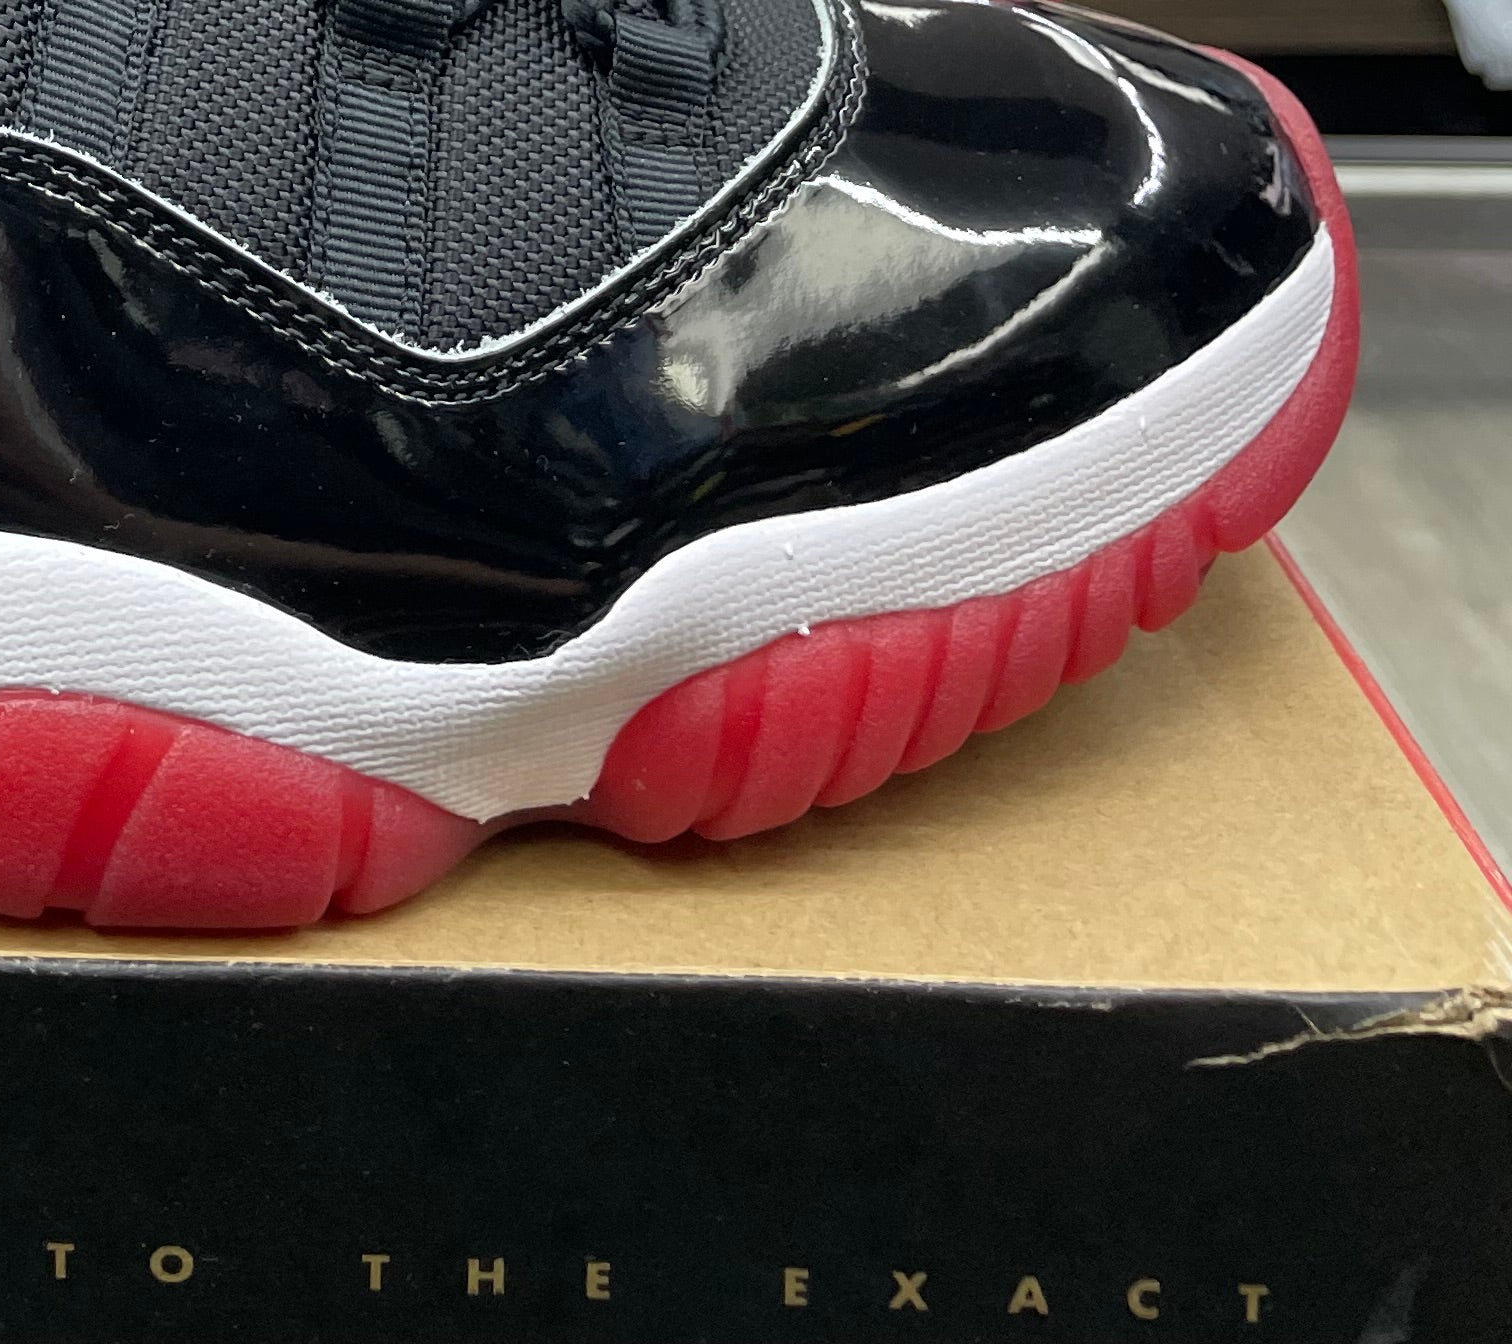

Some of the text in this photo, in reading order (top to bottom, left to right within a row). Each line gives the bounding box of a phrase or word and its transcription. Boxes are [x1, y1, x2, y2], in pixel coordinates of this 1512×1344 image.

[46, 1242, 195, 1284] TO
[361, 1253, 610, 1299] THE
[783, 1267, 1269, 1323] EXACT
